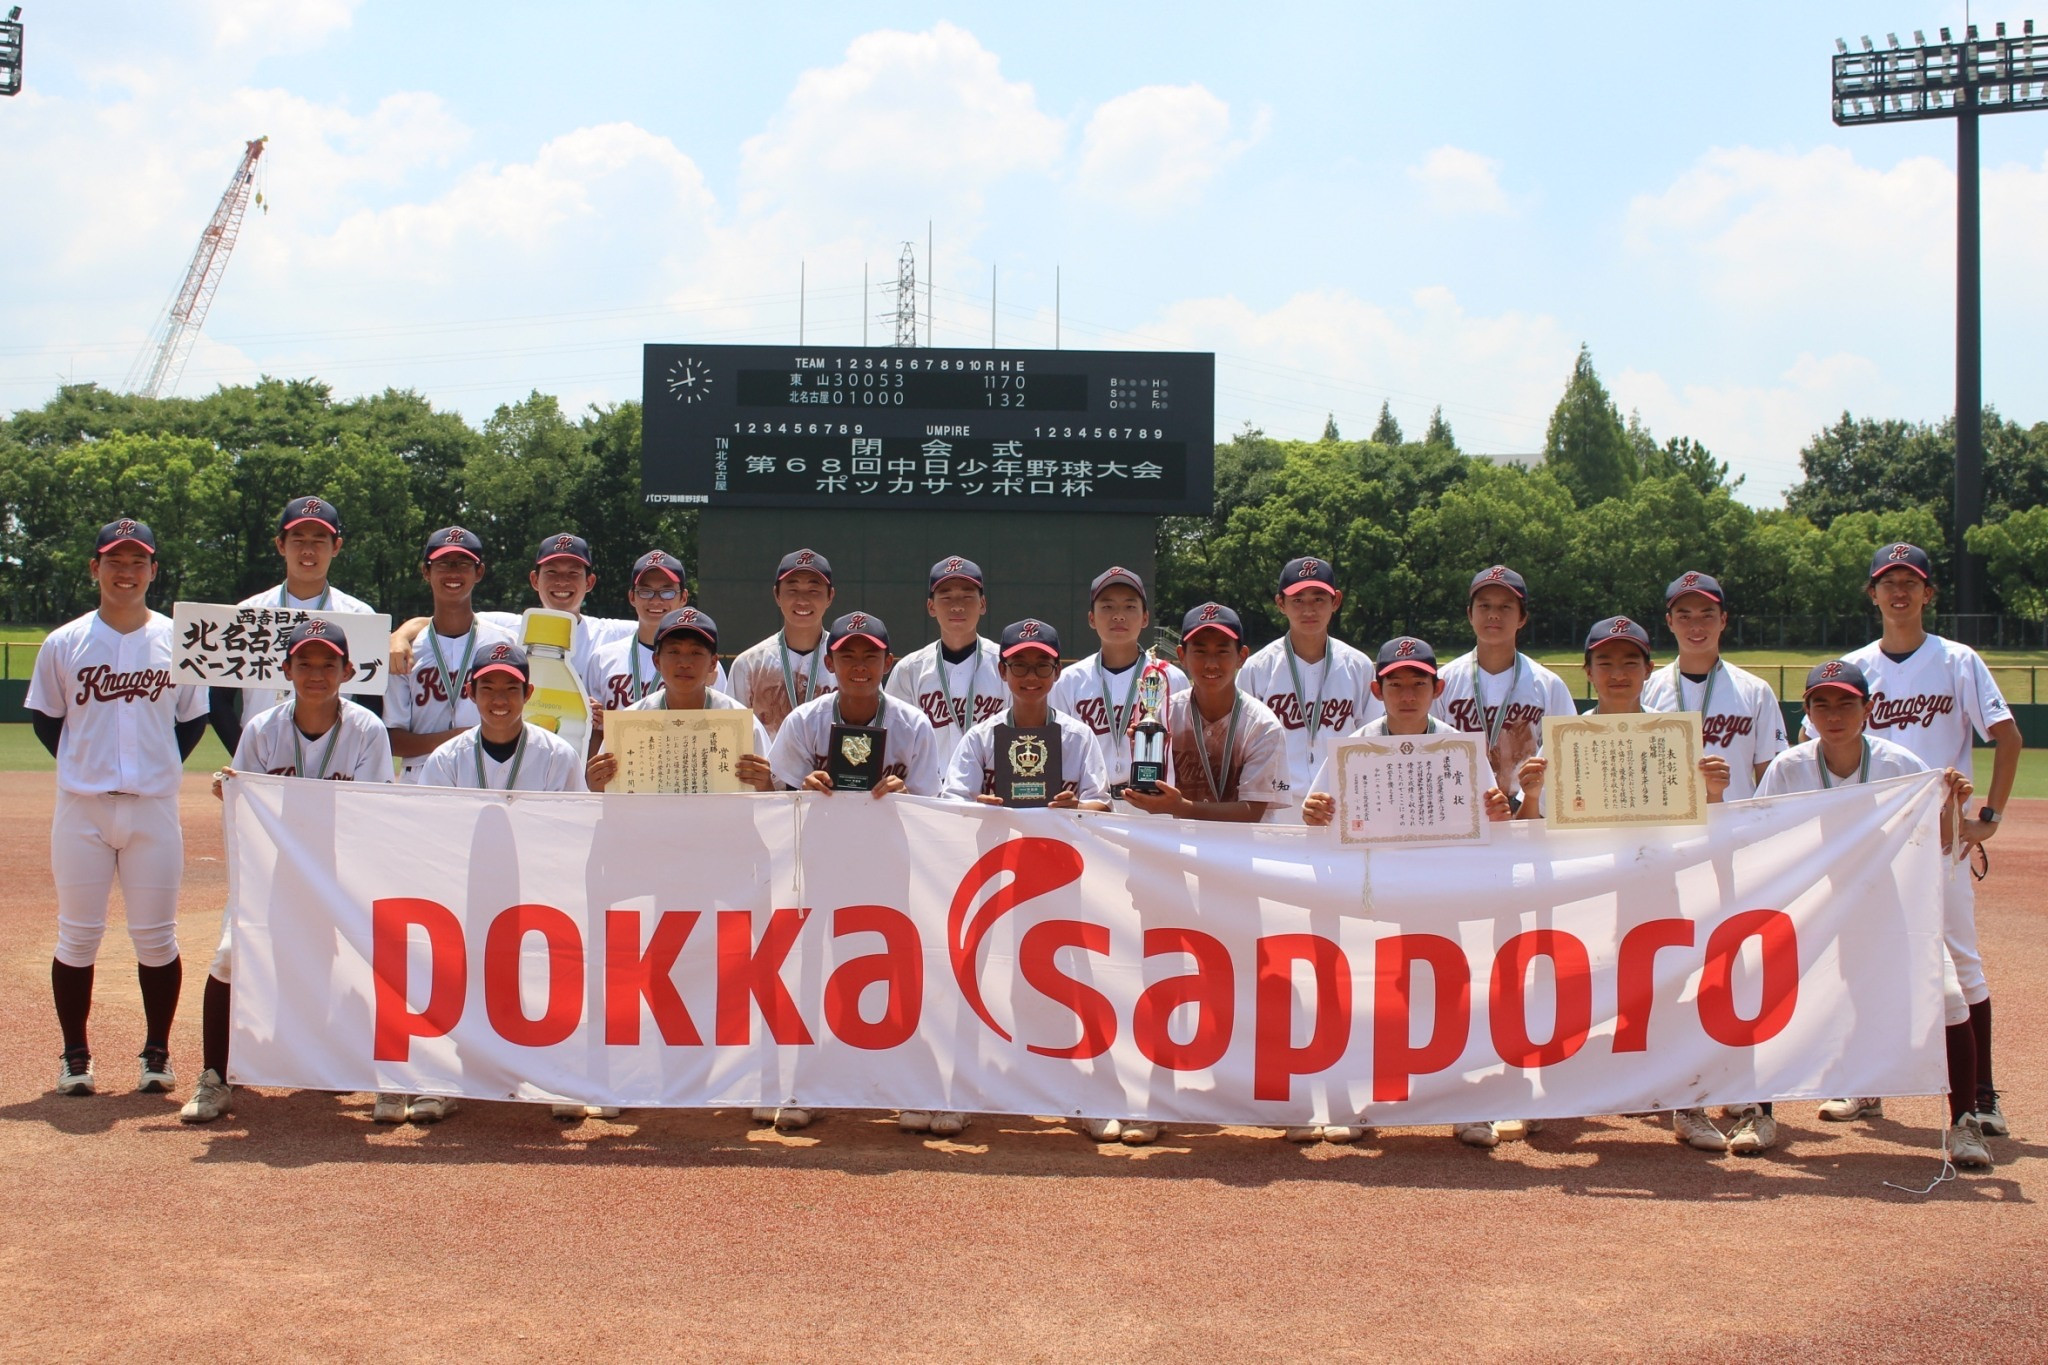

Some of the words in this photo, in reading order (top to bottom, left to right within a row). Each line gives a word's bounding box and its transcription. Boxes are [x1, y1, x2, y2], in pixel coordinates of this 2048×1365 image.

[795, 358, 825, 369] TEAM
[836, 358, 842, 368] 1
[850, 359, 858, 369] 2
[865, 359, 872, 369] 3
[880, 360, 888, 369] 4
[896, 360, 902, 369] 5
[910, 360, 918, 370] 6
[926, 360, 933, 370] 7
[941, 360, 948, 370] 8
[956, 361, 964, 370] 9
[970, 361, 980, 370] 10
[986, 361, 994, 371] R
[1001, 362, 1009, 371] H
[1017, 362, 1024, 371] E
[790, 392, 829, 404] 北名古屋
[734, 424, 740, 433] 1
[748, 424, 756, 433] 2
[764, 424, 771, 433] 3
[778, 424, 786, 433] 4
[794, 424, 802, 434] 5
[809, 424, 817, 434] 6
[824, 424, 832, 434] 7
[840, 424, 848, 434] 8
[855, 424, 862, 434] 9
[926, 426, 970, 436] UMPIRE
[1035, 428, 1040, 437] 1
[1049, 428, 1056, 437] 2
[1064, 428, 1072, 438] 3
[1079, 428, 1087, 438] 4
[1094, 428, 1102, 438] 5
[1109, 428, 1117, 438] 6
[1124, 429, 1132, 438] 7
[1140, 429, 1147, 438] 8
[1154, 429, 1162, 439] 9
[816, 475, 1093, 496] ポッカサッポロ杯
[237, 609, 310, 626] 西春日井
[179, 655, 382, 682] ベースボーブ
[718, 747, 730, 772] 賞状
[1666, 749, 1678, 786] 表彰状
[1452, 770, 1464, 806] 賞状
